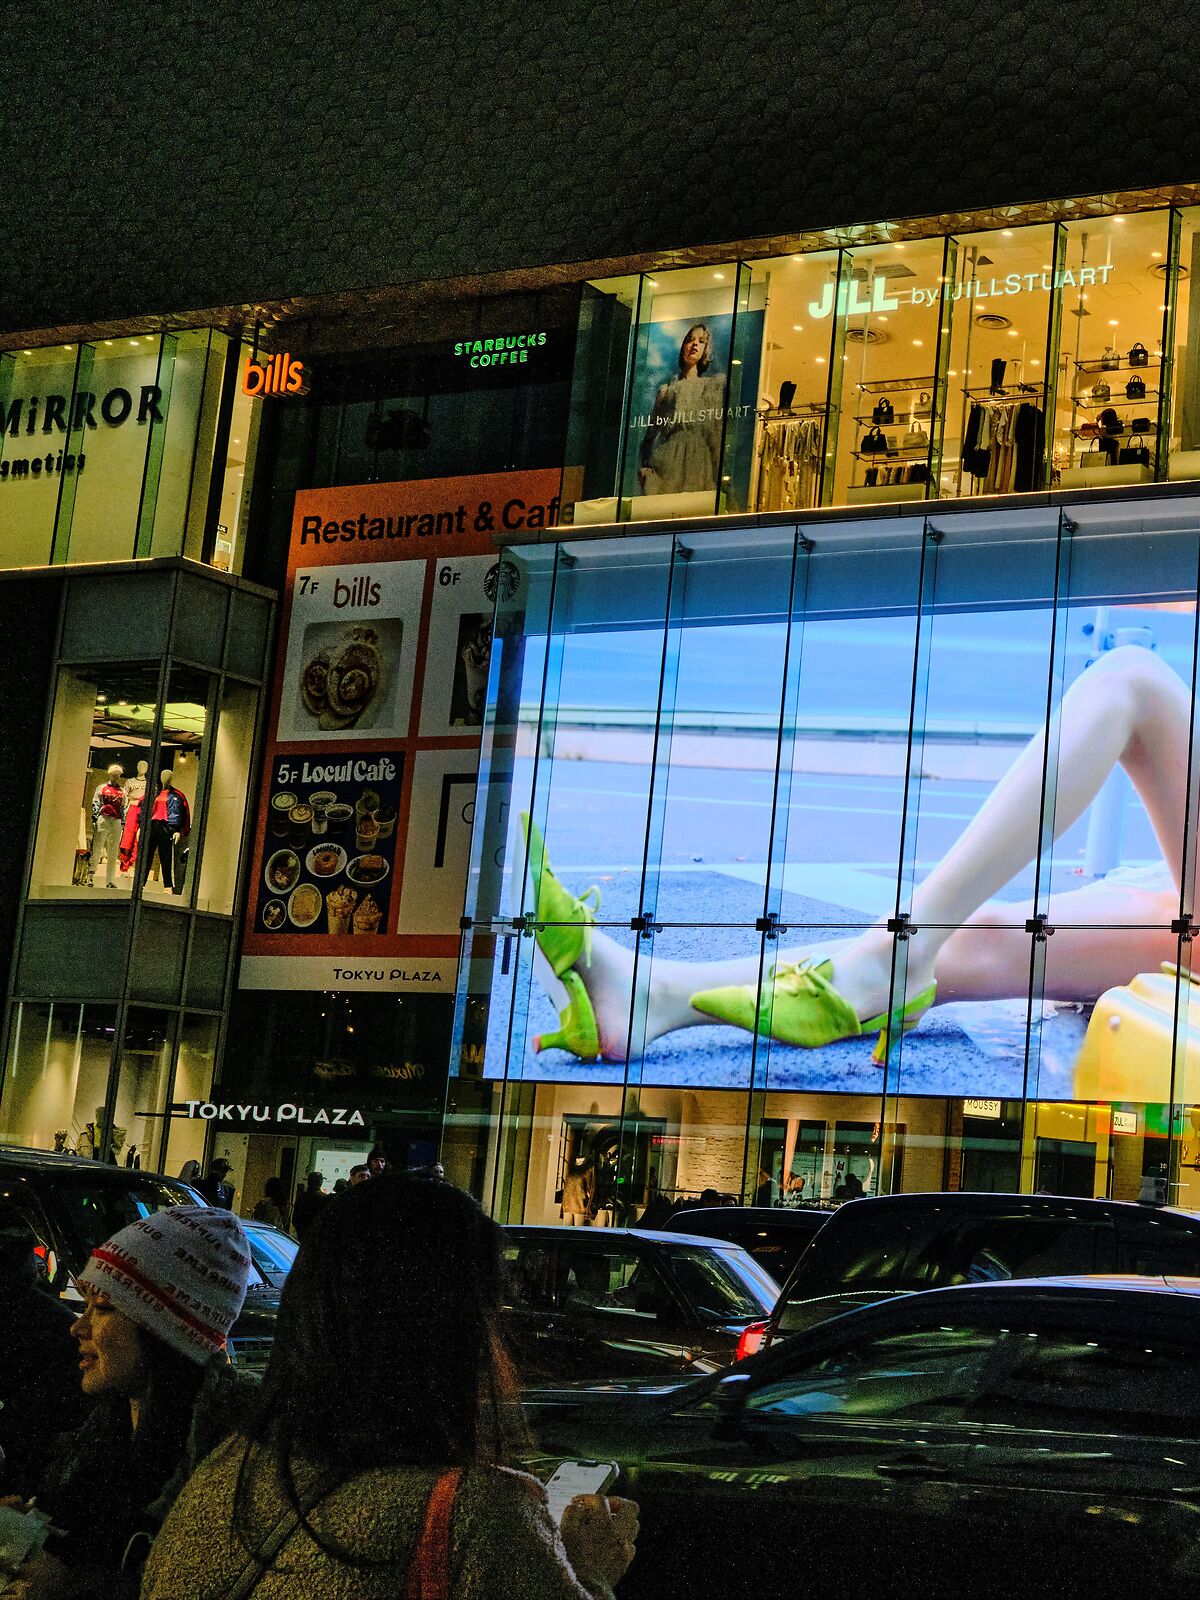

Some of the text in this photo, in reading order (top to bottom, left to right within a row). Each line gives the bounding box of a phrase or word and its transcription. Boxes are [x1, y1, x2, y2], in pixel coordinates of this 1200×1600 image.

[808, 265, 1115, 319] JILL by JILLSTUART
[454, 333, 547, 356] STARBUCKS
[470, 351, 528, 369] COFFEE
[242, 352, 304, 397] bills
[630, 414, 655, 428] JILL
[656, 415, 670, 427] by
[300, 508, 466, 545] Restaurant
[473, 501, 496, 531] &
[439, 566, 461, 586] 6F
[299, 575, 382, 608] 7F bills
[277, 763, 298, 784] 5F
[333, 968, 442, 981] TOKYU PLAZA
[185, 1101, 365, 1126] TOKYU PLAZA
